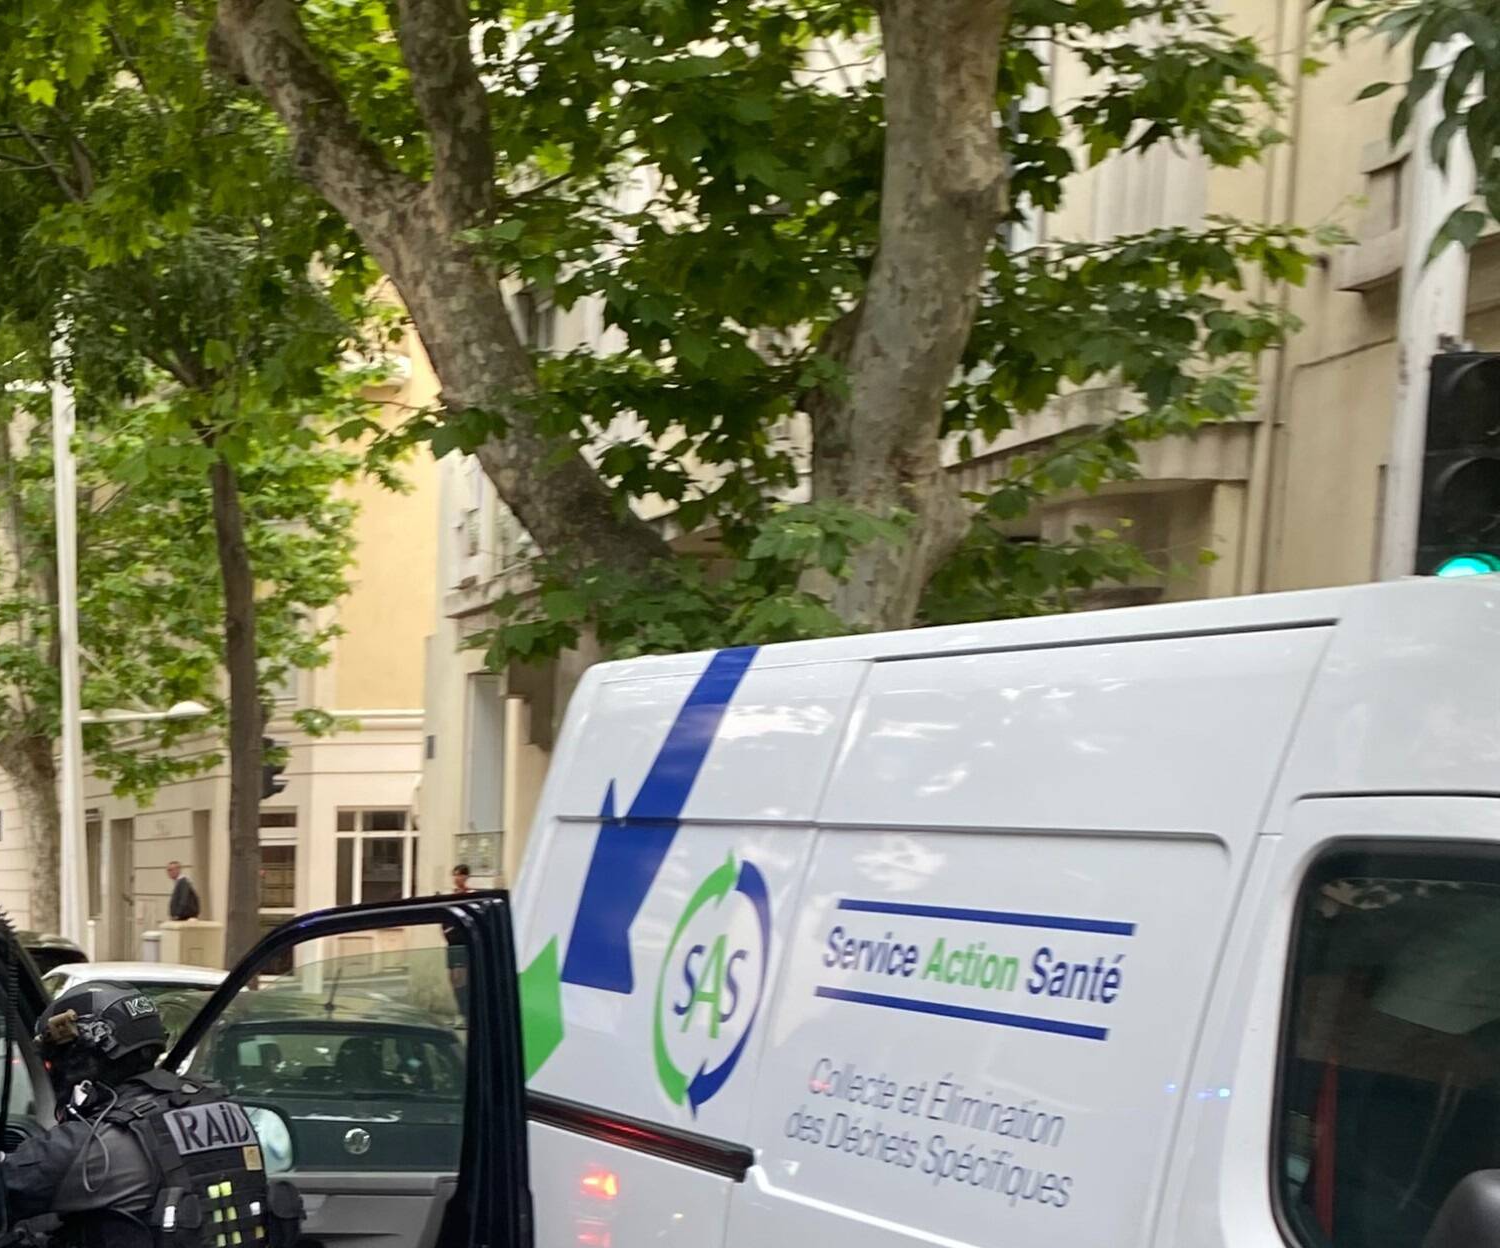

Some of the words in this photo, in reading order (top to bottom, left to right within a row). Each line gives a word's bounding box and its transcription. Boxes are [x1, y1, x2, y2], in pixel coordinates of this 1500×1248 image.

[673, 933, 749, 1039] SAS
[822, 925, 919, 977] Service
[921, 937, 1021, 992] Action
[1027, 946, 1126, 1004] Santé
[808, 1057, 898, 1110] Collecte
[899, 1080, 928, 1117] et
[927, 1072, 1066, 1148] Élimination
[784, 1103, 826, 1145] des
[825, 1111, 921, 1169] Déchets
[919, 1134, 1074, 1209] Spécifiques
